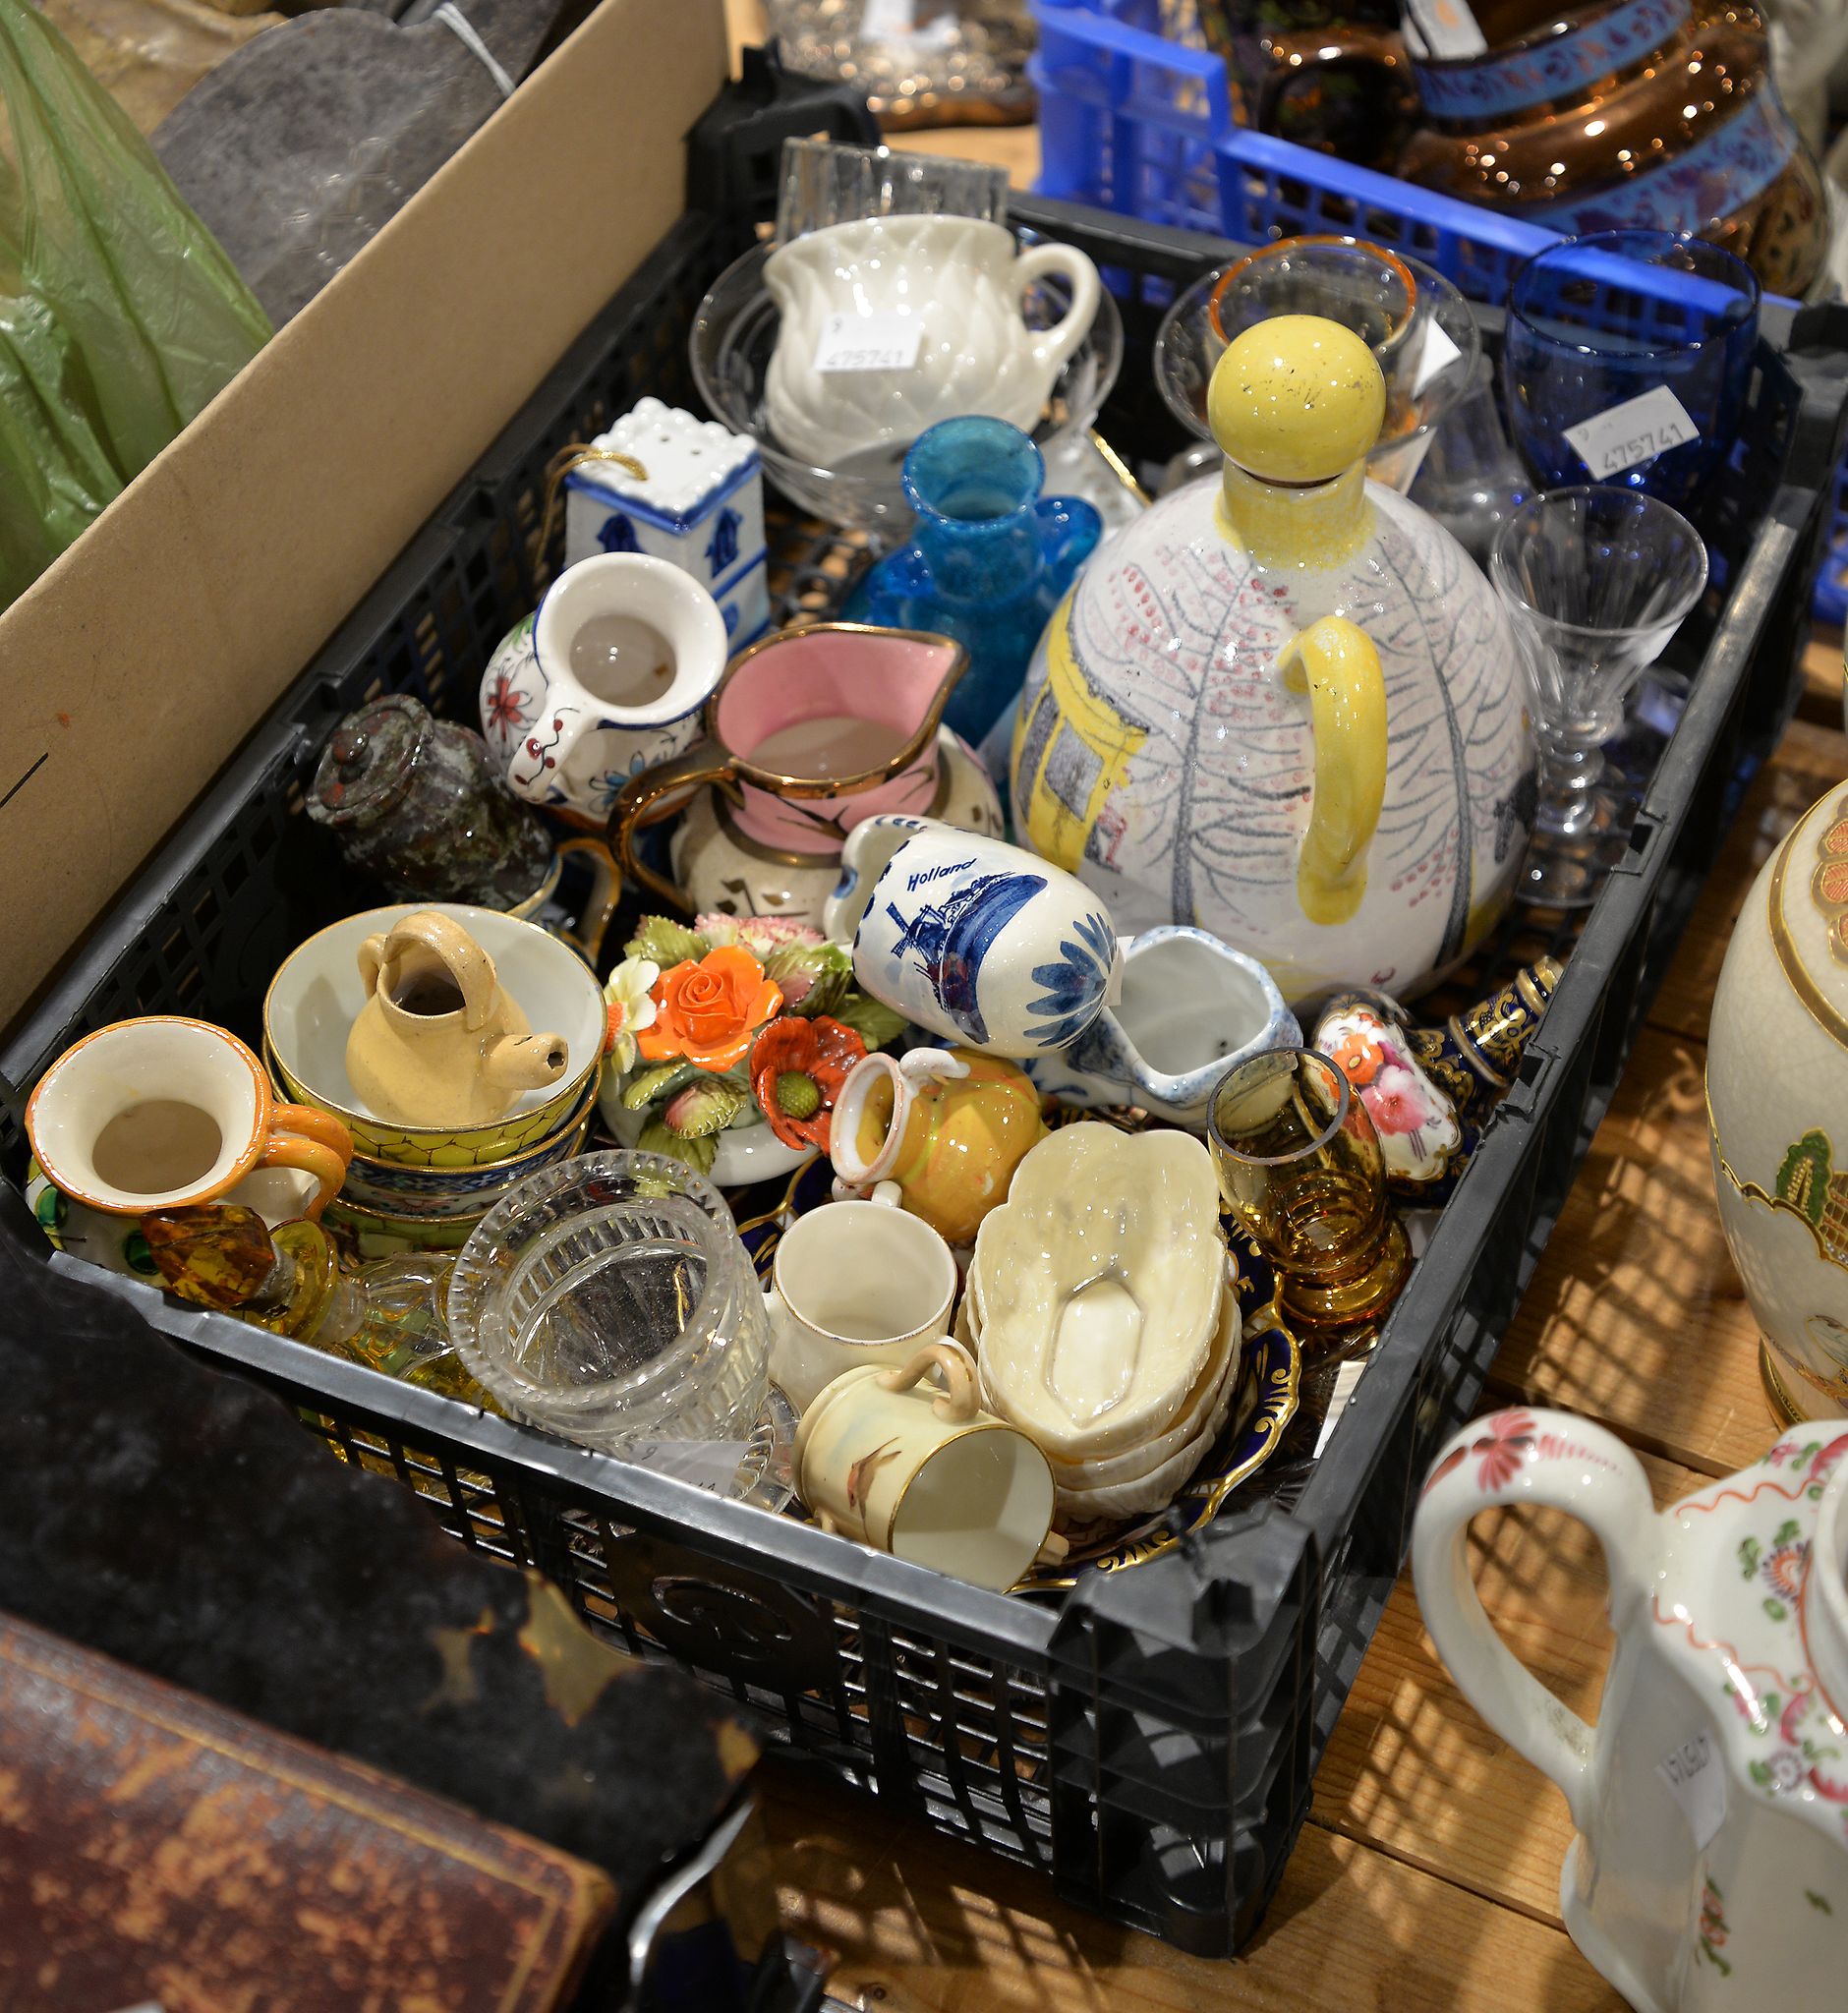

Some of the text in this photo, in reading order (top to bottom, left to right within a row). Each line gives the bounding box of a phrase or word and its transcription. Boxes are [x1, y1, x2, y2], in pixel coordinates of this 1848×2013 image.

[826, 349, 904, 367] 475741
[1603, 423, 1684, 470] 475741
[906, 857, 978, 892] Holland
